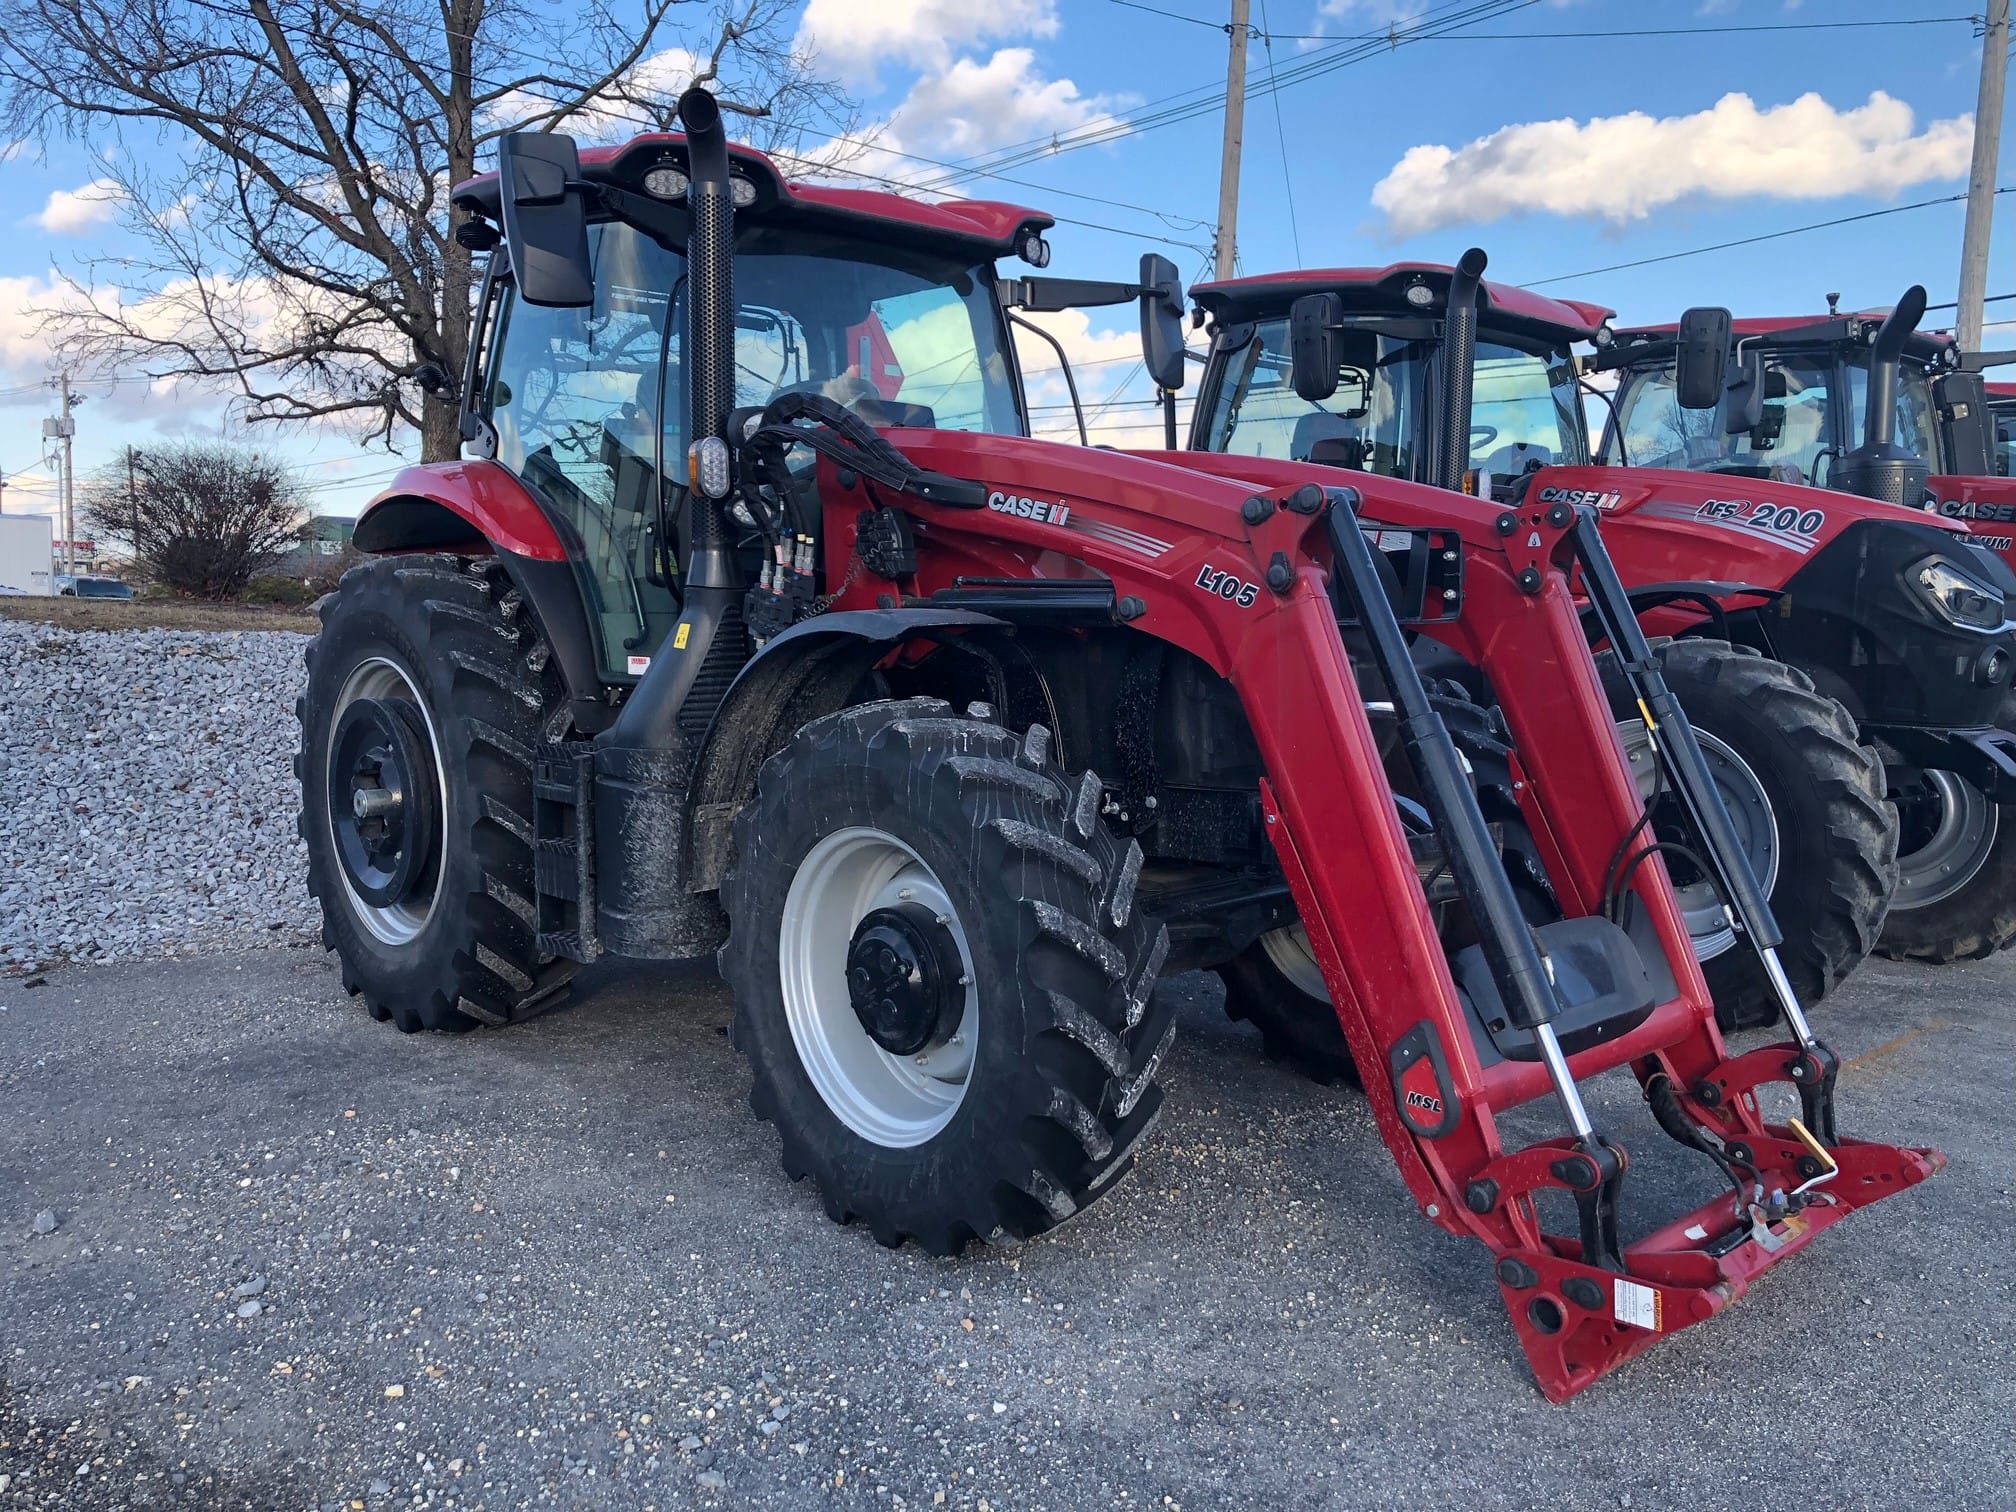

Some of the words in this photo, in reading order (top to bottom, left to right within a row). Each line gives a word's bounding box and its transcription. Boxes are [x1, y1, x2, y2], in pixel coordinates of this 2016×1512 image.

[988, 491, 1049, 521] CASE
[1538, 486, 1599, 505] CASE
[1940, 500, 2016, 521] CASE
[1695, 499, 1741, 518] AFS
[1745, 502, 1825, 536] 200
[1194, 563, 1260, 609] L105
[1406, 1090, 1442, 1113] MSL
[1654, 1298, 1662, 1331] WARNING
